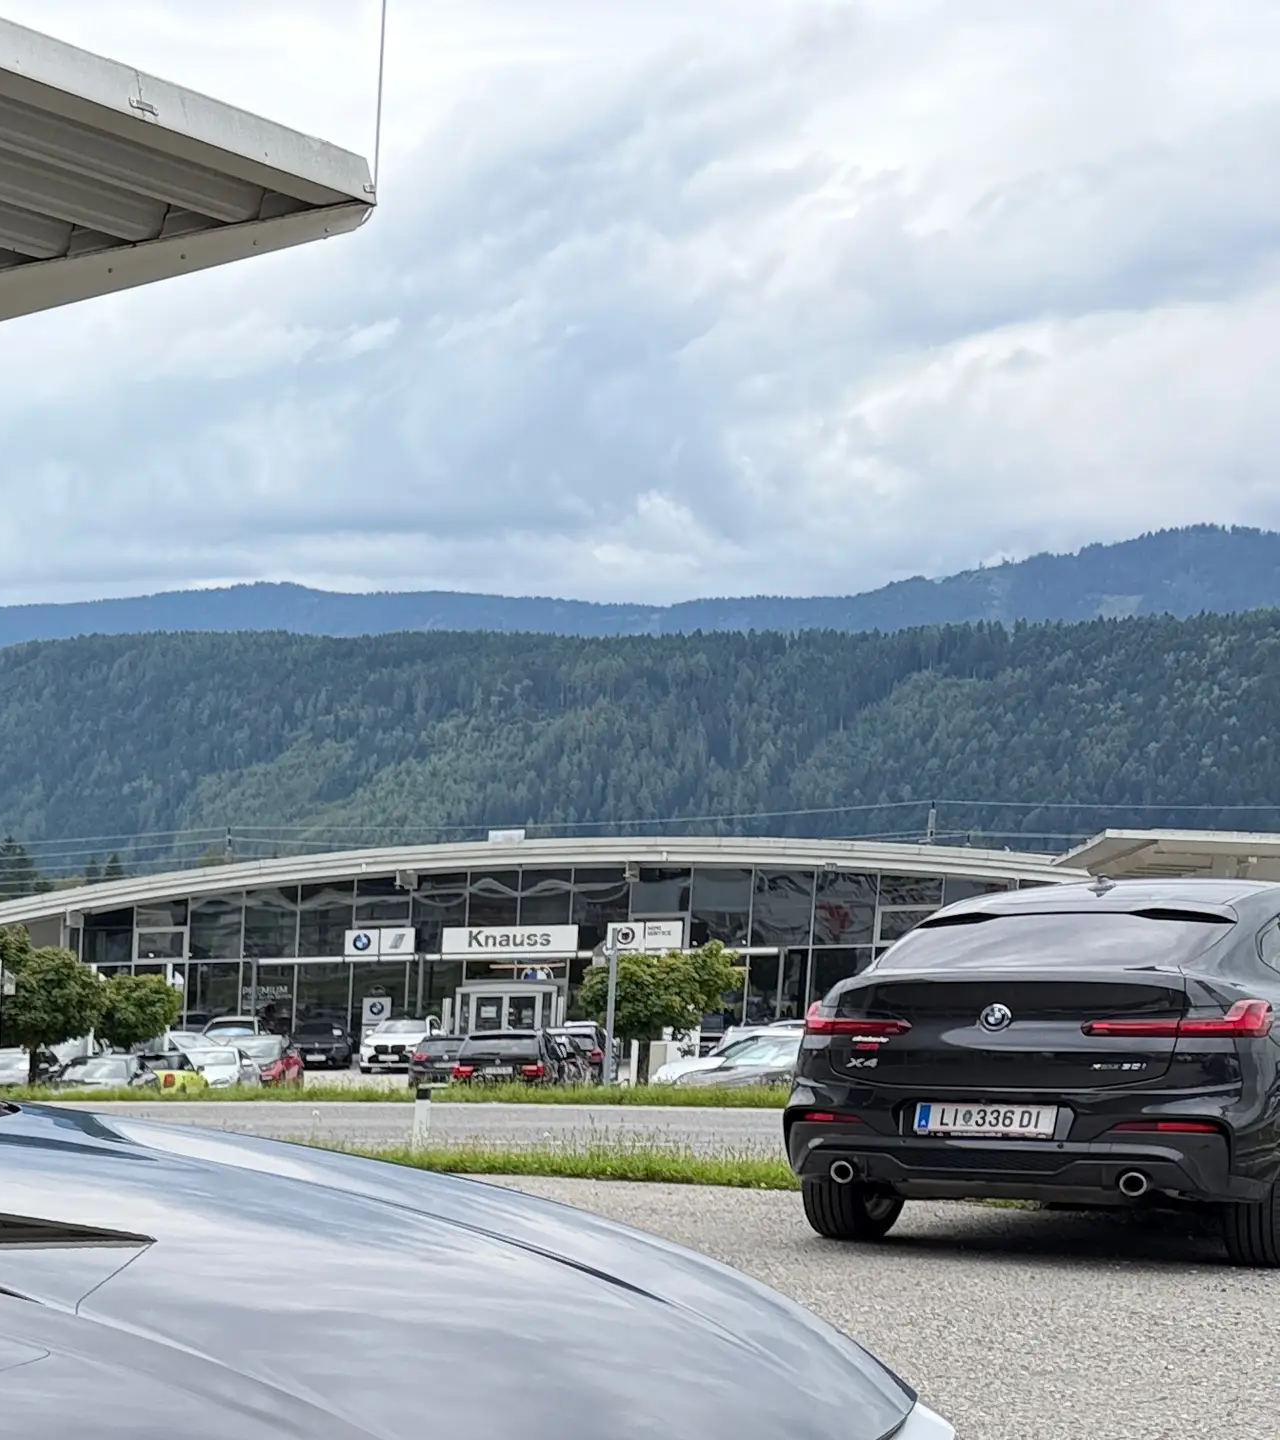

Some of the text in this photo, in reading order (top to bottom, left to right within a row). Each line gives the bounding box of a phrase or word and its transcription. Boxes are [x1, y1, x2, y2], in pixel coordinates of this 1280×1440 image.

[468, 930, 552, 949] Knauss
[845, 1057, 879, 1069] X4
[939, 1107, 1042, 1130] LI 336 DI
